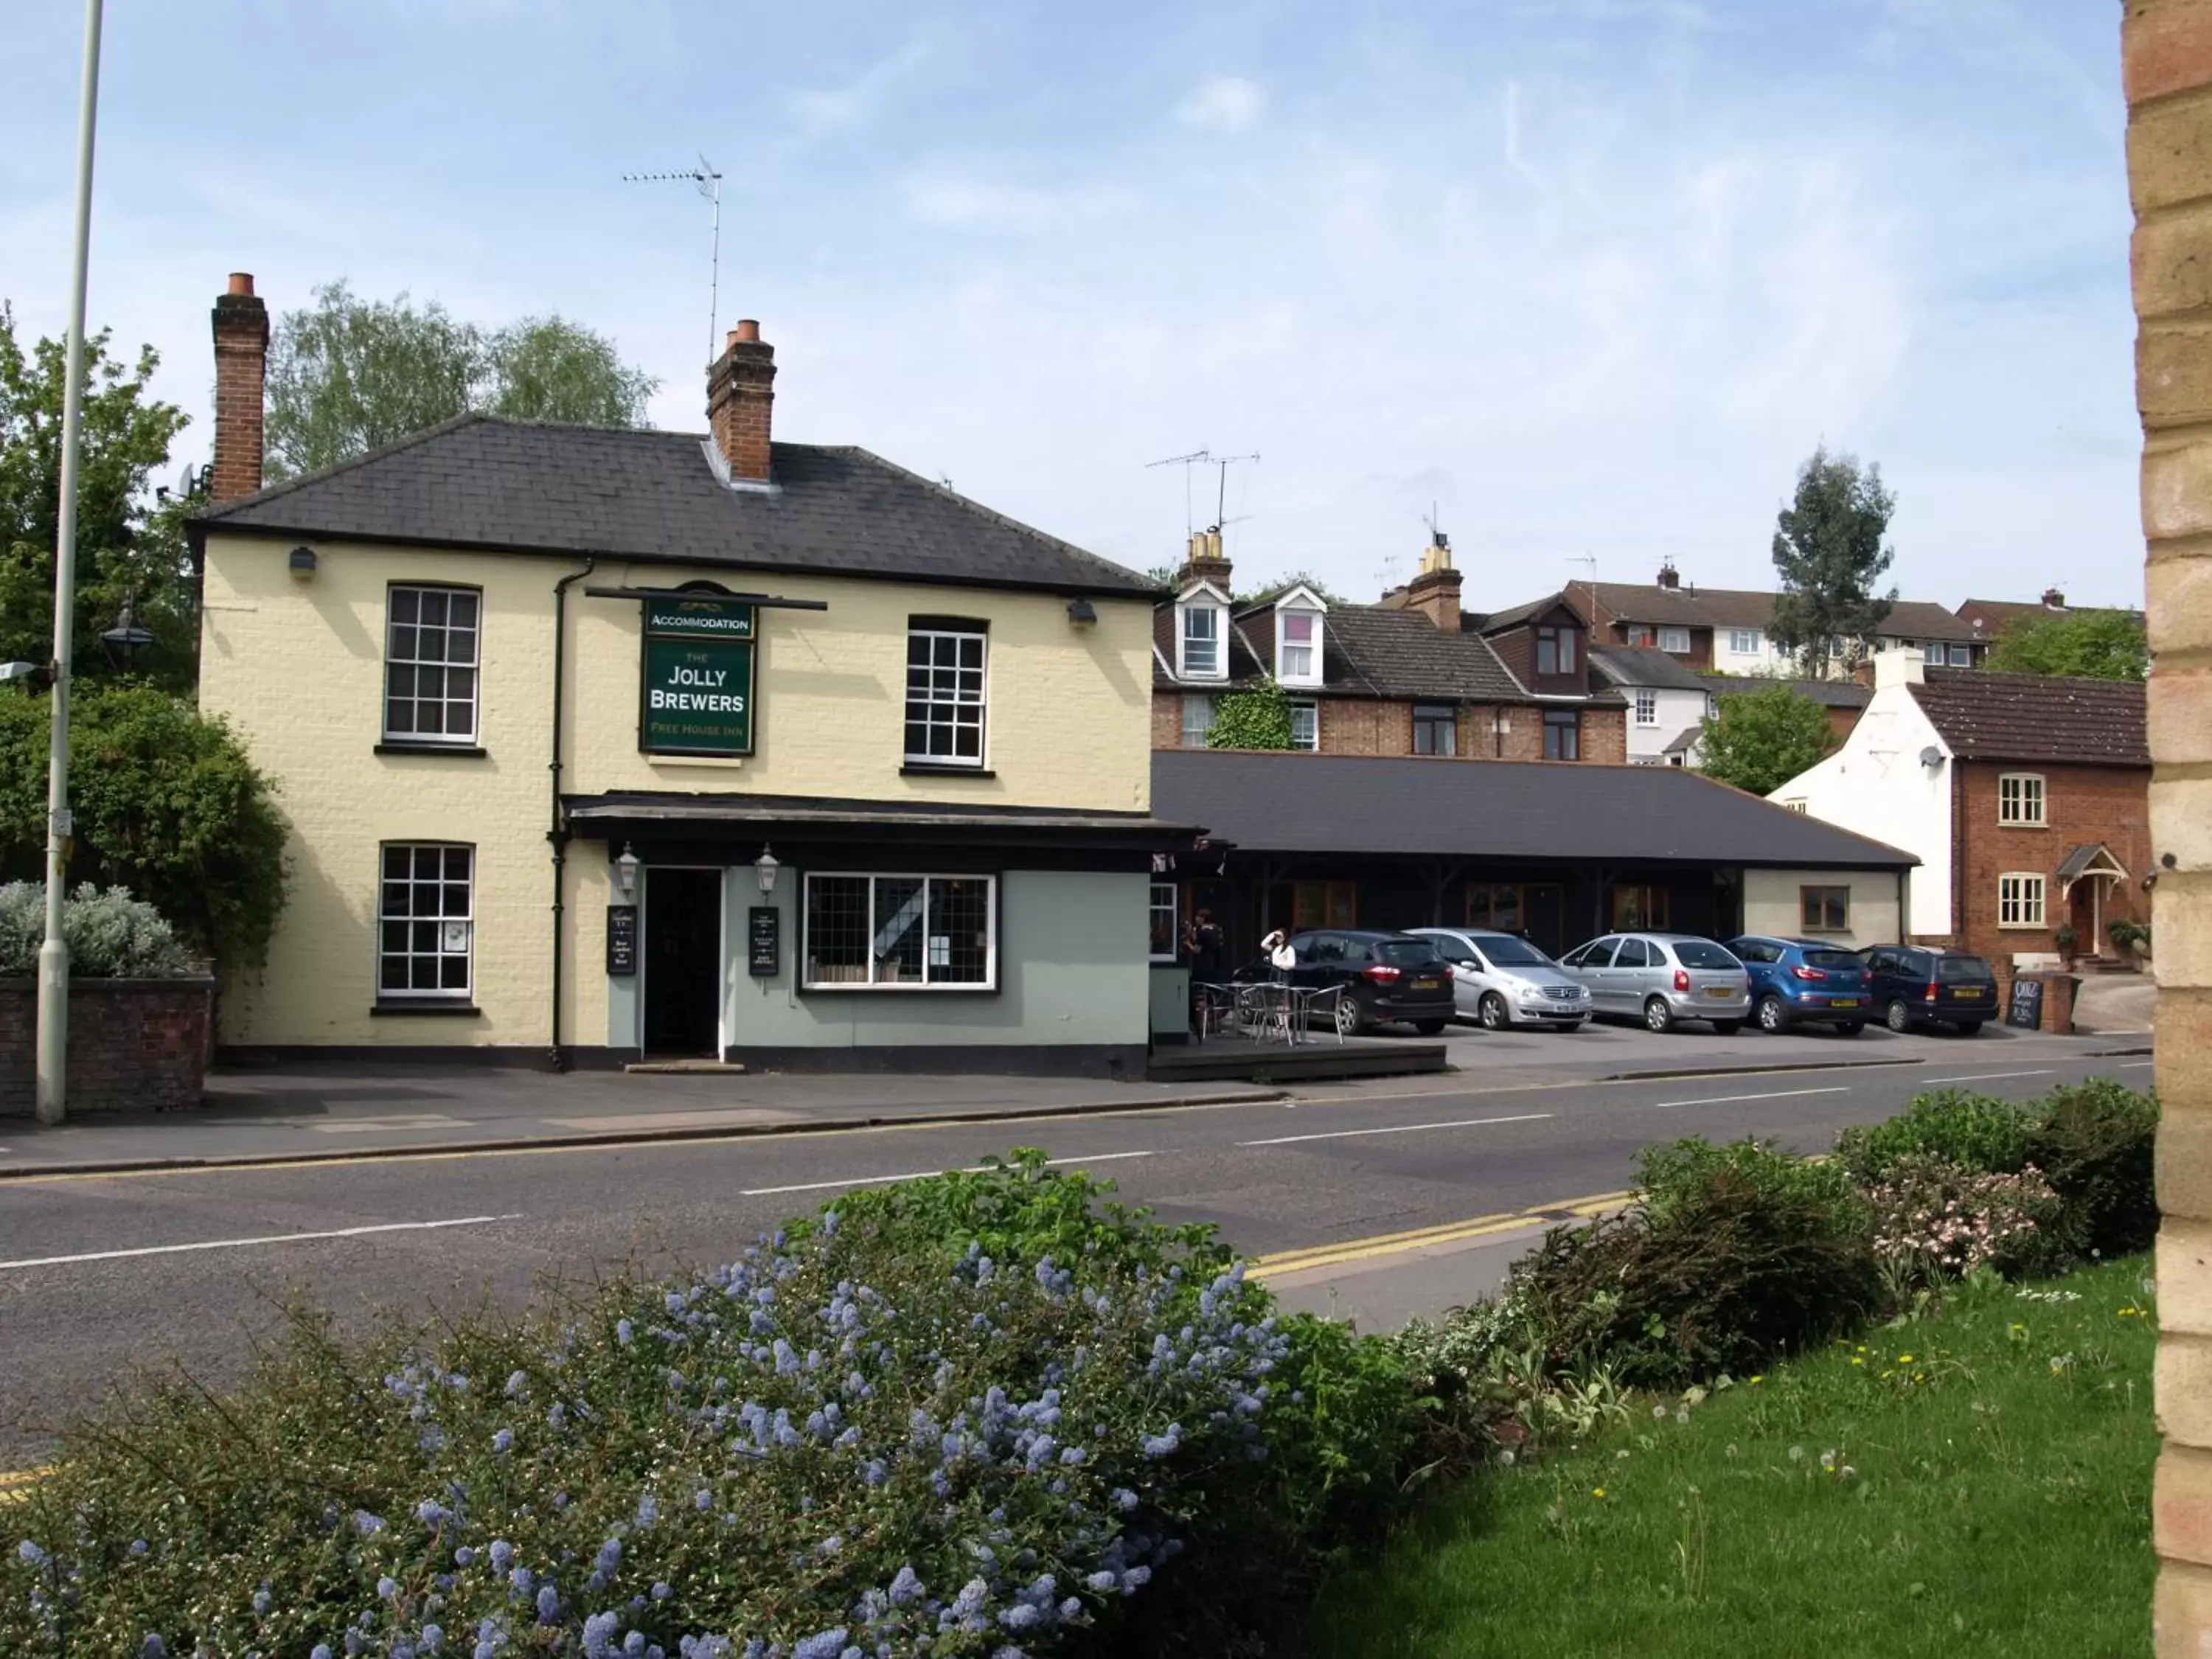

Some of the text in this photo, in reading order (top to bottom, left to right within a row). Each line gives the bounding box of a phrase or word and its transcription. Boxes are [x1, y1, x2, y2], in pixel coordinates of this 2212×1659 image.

[652, 614, 748, 630] ACCOMMODATION
[686, 653, 709, 663] THE
[668, 666, 727, 686] JOLLY
[650, 689, 744, 712] BREWERS
[651, 723, 743, 737] FREE HOUSE INN
